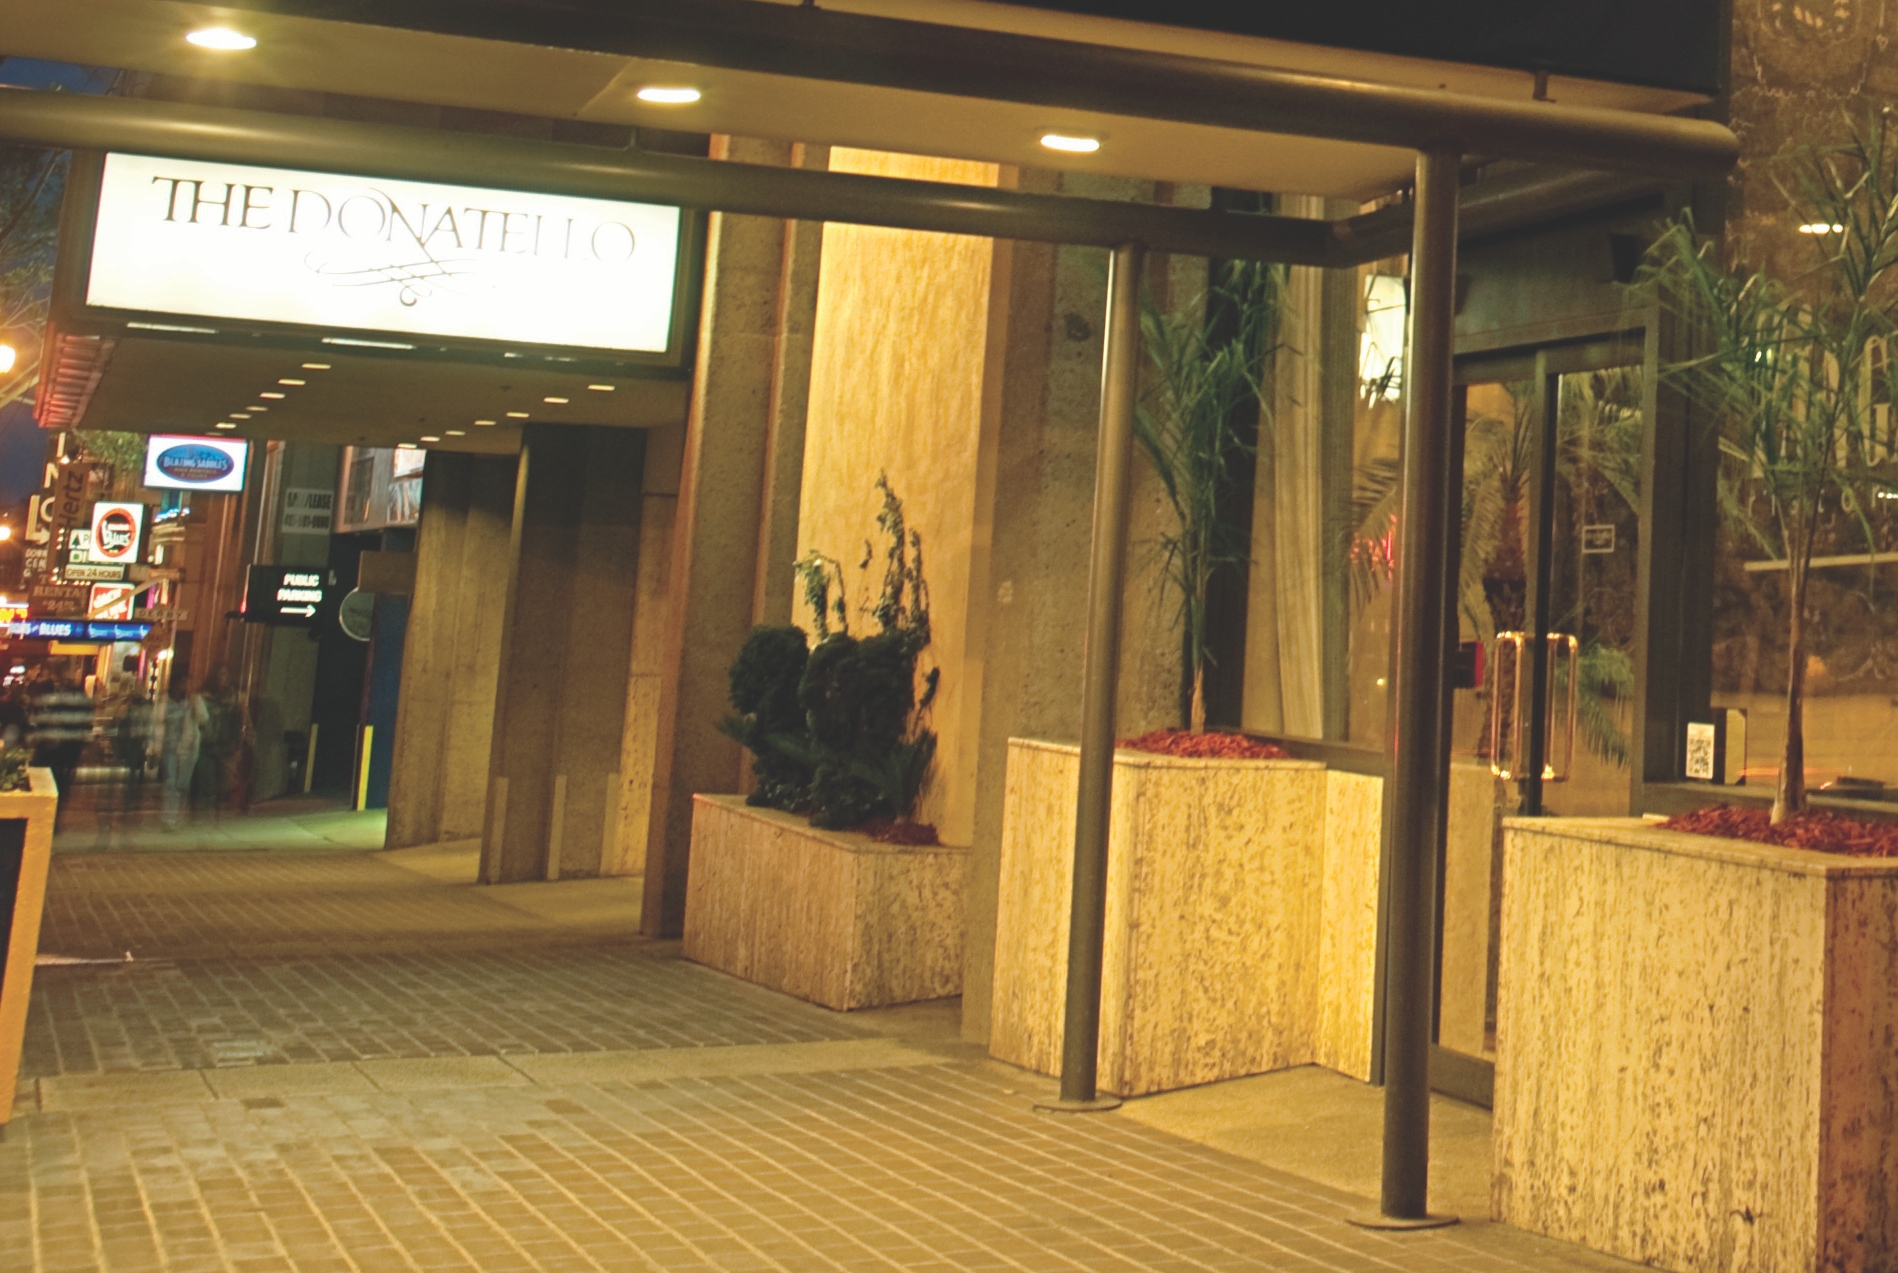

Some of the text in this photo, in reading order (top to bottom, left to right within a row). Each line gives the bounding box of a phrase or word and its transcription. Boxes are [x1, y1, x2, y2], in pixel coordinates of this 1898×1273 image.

[151, 175, 637, 264] THE DONATELLO
[57, 470, 84, 535] Hertz
[276, 588, 323, 603] PARKING
[283, 573, 320, 587] PUBLIC
